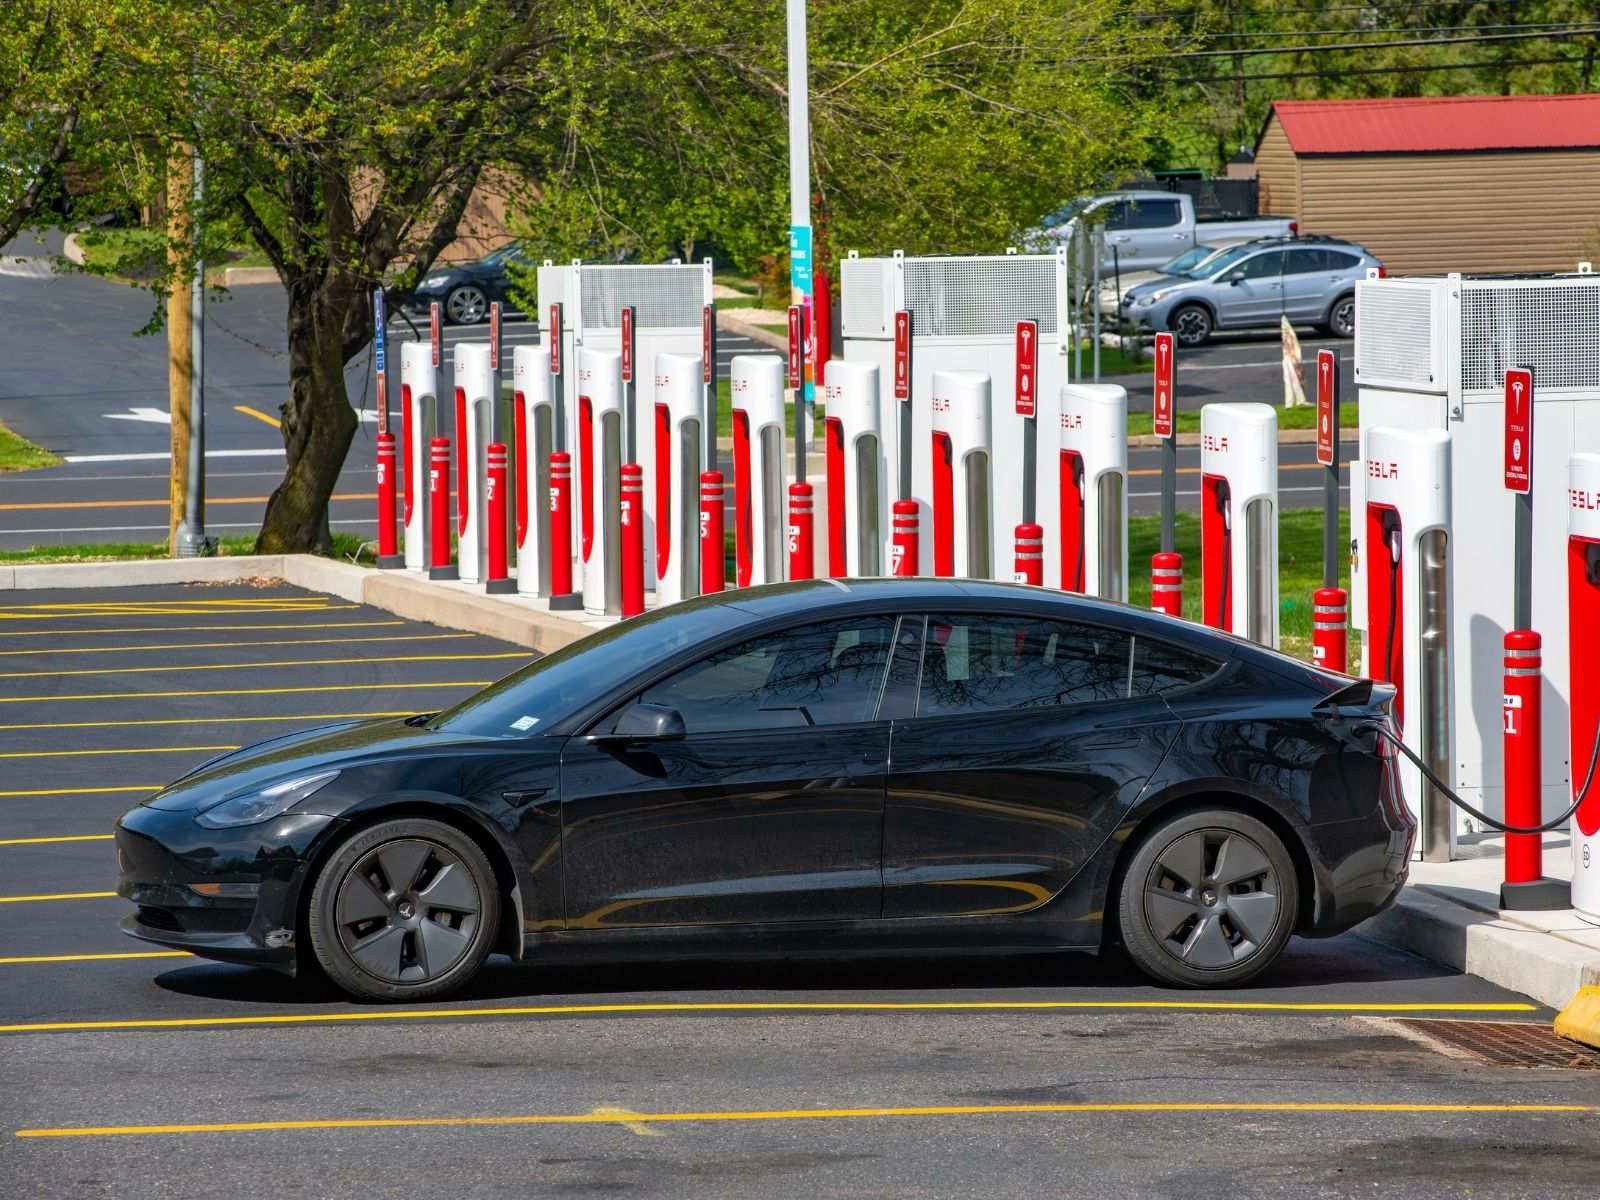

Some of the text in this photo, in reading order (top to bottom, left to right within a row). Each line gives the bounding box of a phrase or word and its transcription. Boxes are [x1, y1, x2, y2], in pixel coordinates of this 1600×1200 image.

[1203, 434, 1228, 453] ESLA
[1366, 459, 1398, 480] ESLA
[1503, 709, 1517, 735] 1
